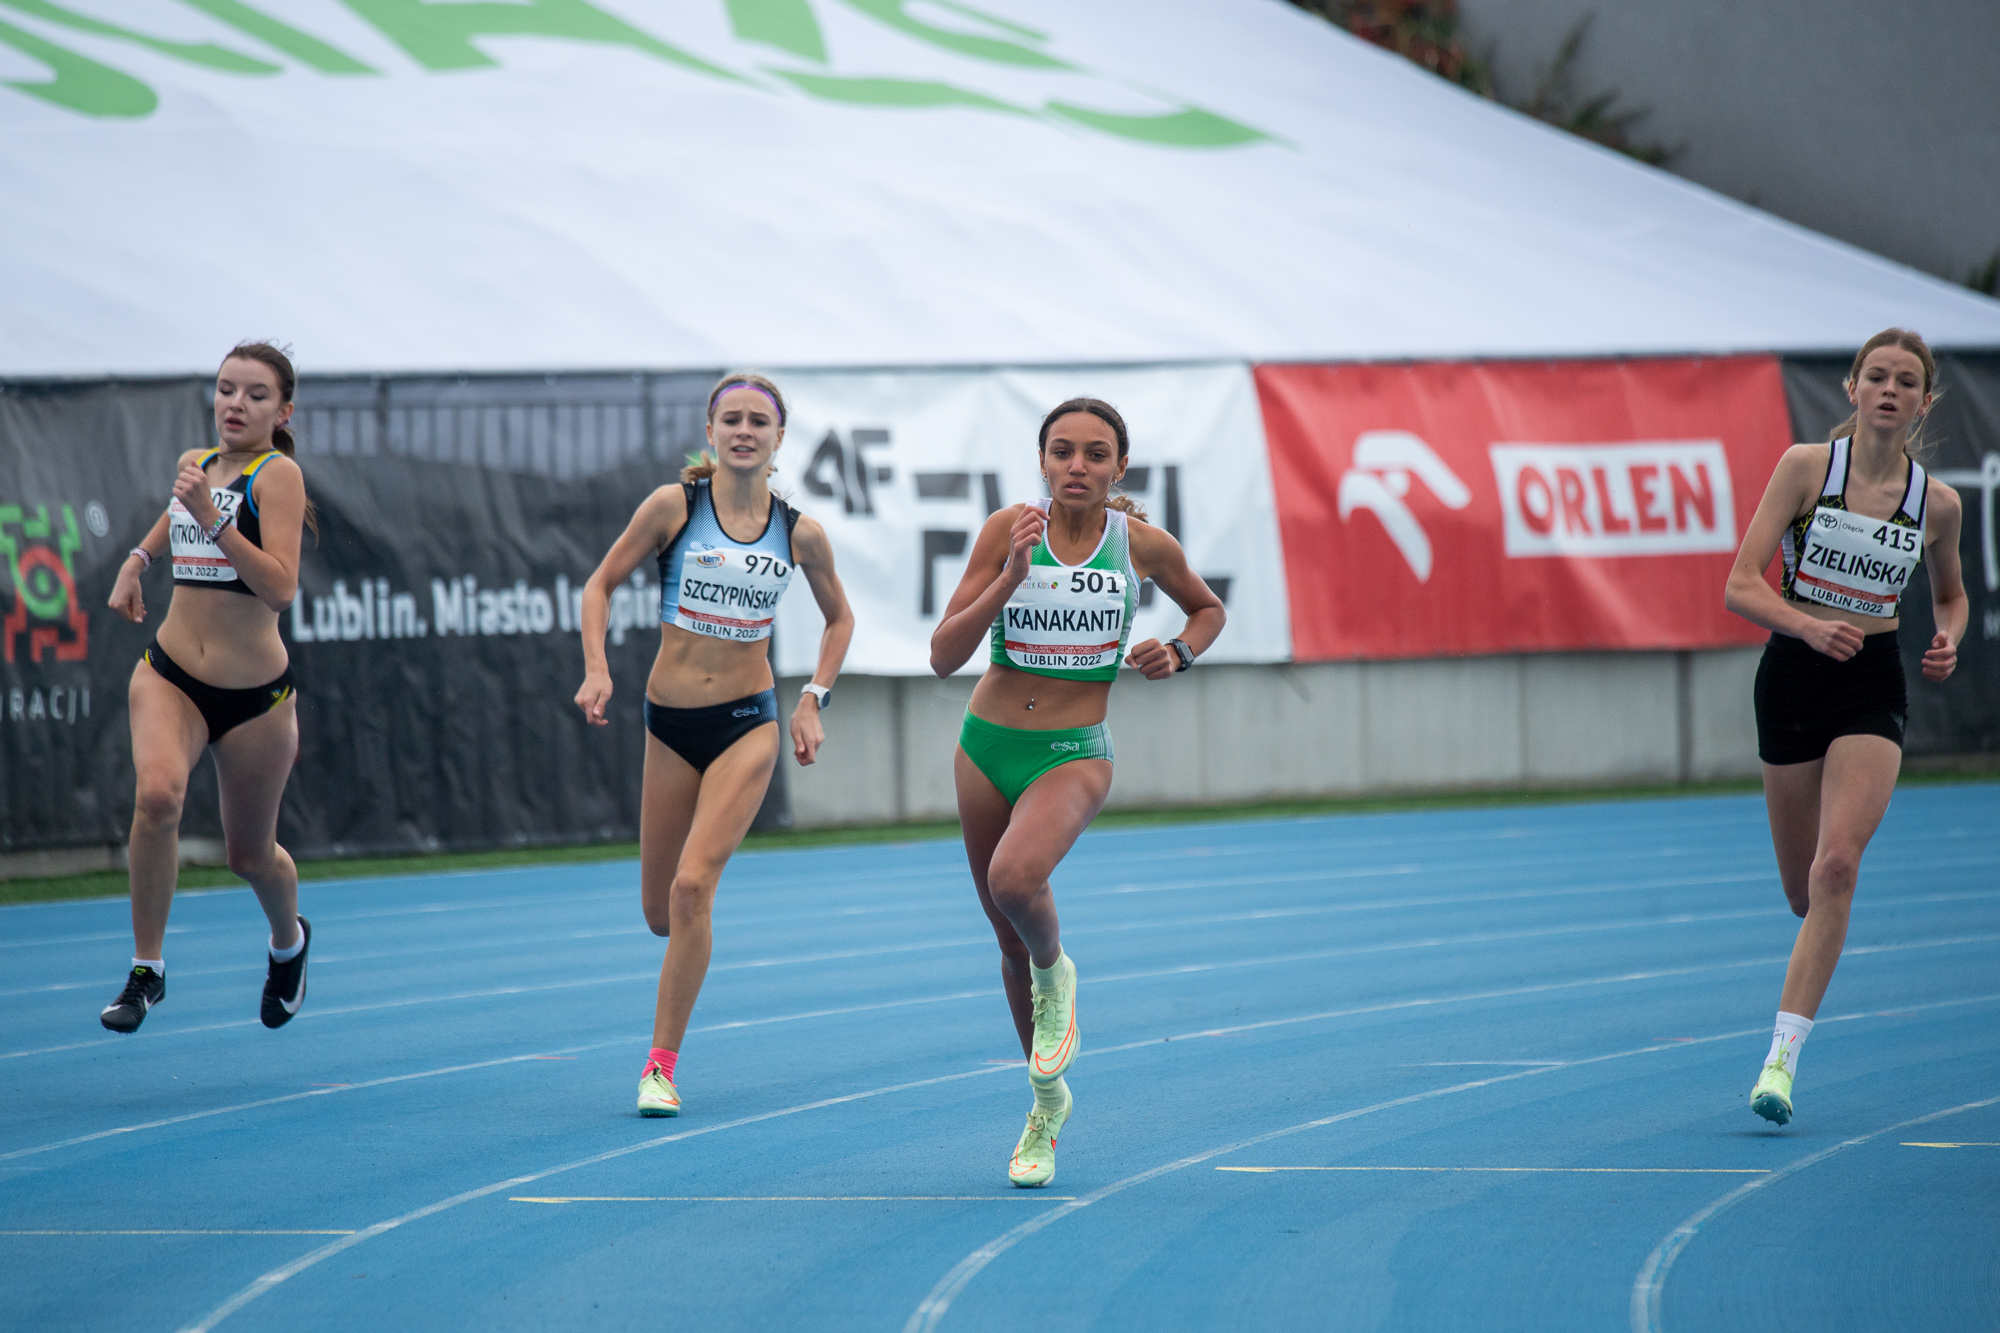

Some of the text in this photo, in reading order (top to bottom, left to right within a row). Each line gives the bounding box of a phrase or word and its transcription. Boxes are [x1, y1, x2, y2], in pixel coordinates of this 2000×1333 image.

[1515, 460, 1717, 536] ORLEN
[1872, 525, 1917, 552] 415
[195, 567, 219, 577] 2022
[1806, 542, 1907, 586] ZIELIŃSKA
[683, 578, 779, 610] SZCZYPIŃSKA
[1070, 571, 1120, 594] 501
[290, 577, 427, 643] Lublin.
[431, 573, 555, 637] Miasto
[1810, 587, 1853, 608] LUBLIN
[1854, 600, 1884, 614] 2022
[692, 620, 760, 639] LUBLIN 2022
[1008, 607, 1121, 632] KANAKANTI
[1023, 653, 1102, 667] LUBLIN 2022
[731, 705, 760, 718] esa
[1050, 741, 1080, 751] esa
